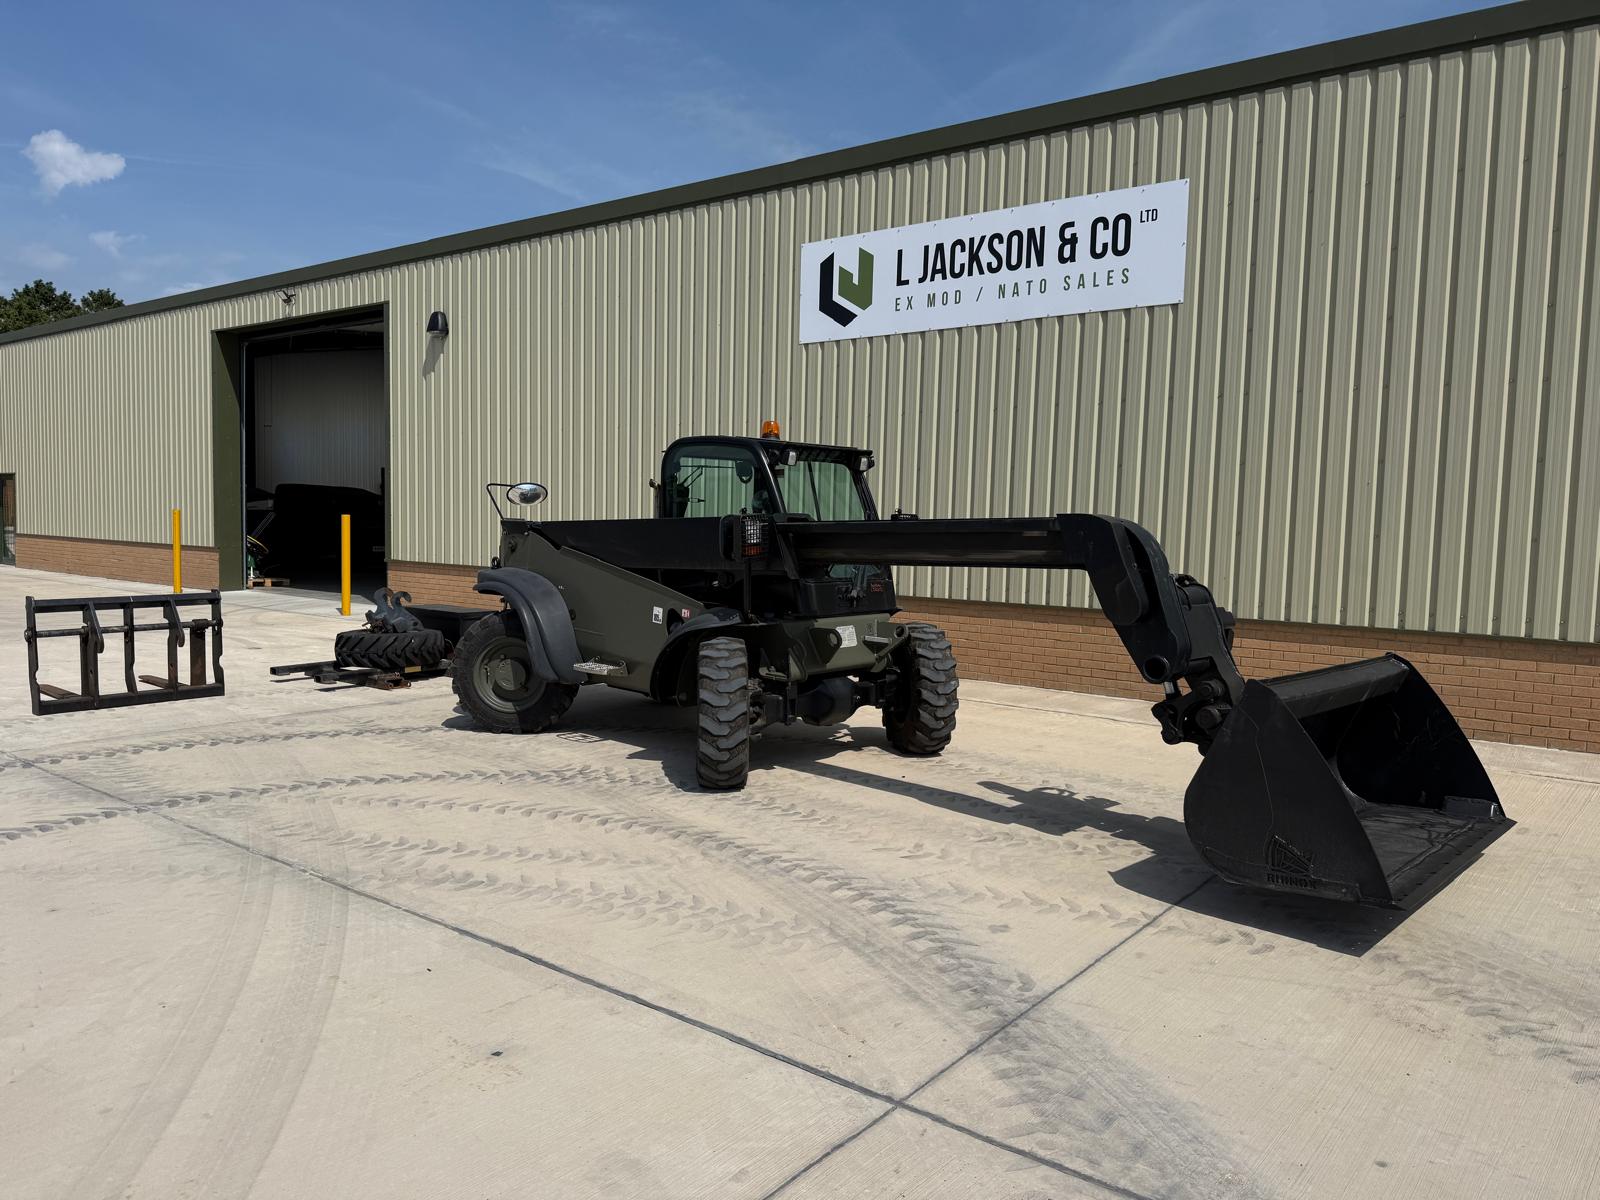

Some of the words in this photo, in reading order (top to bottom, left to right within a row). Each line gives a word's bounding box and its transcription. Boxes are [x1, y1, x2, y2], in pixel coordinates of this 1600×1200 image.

[896, 249, 909, 287] L
[918, 226, 1046, 284] JACKSON
[1057, 221, 1079, 264] &
[1089, 213, 1132, 260] CO
[1140, 208, 1158, 224] LTD
[895, 296, 914, 312] EX
[927, 289, 962, 308] MOD
[976, 286, 984, 302] /
[998, 278, 1048, 300] NATO
[1063, 267, 1131, 291] SALES
